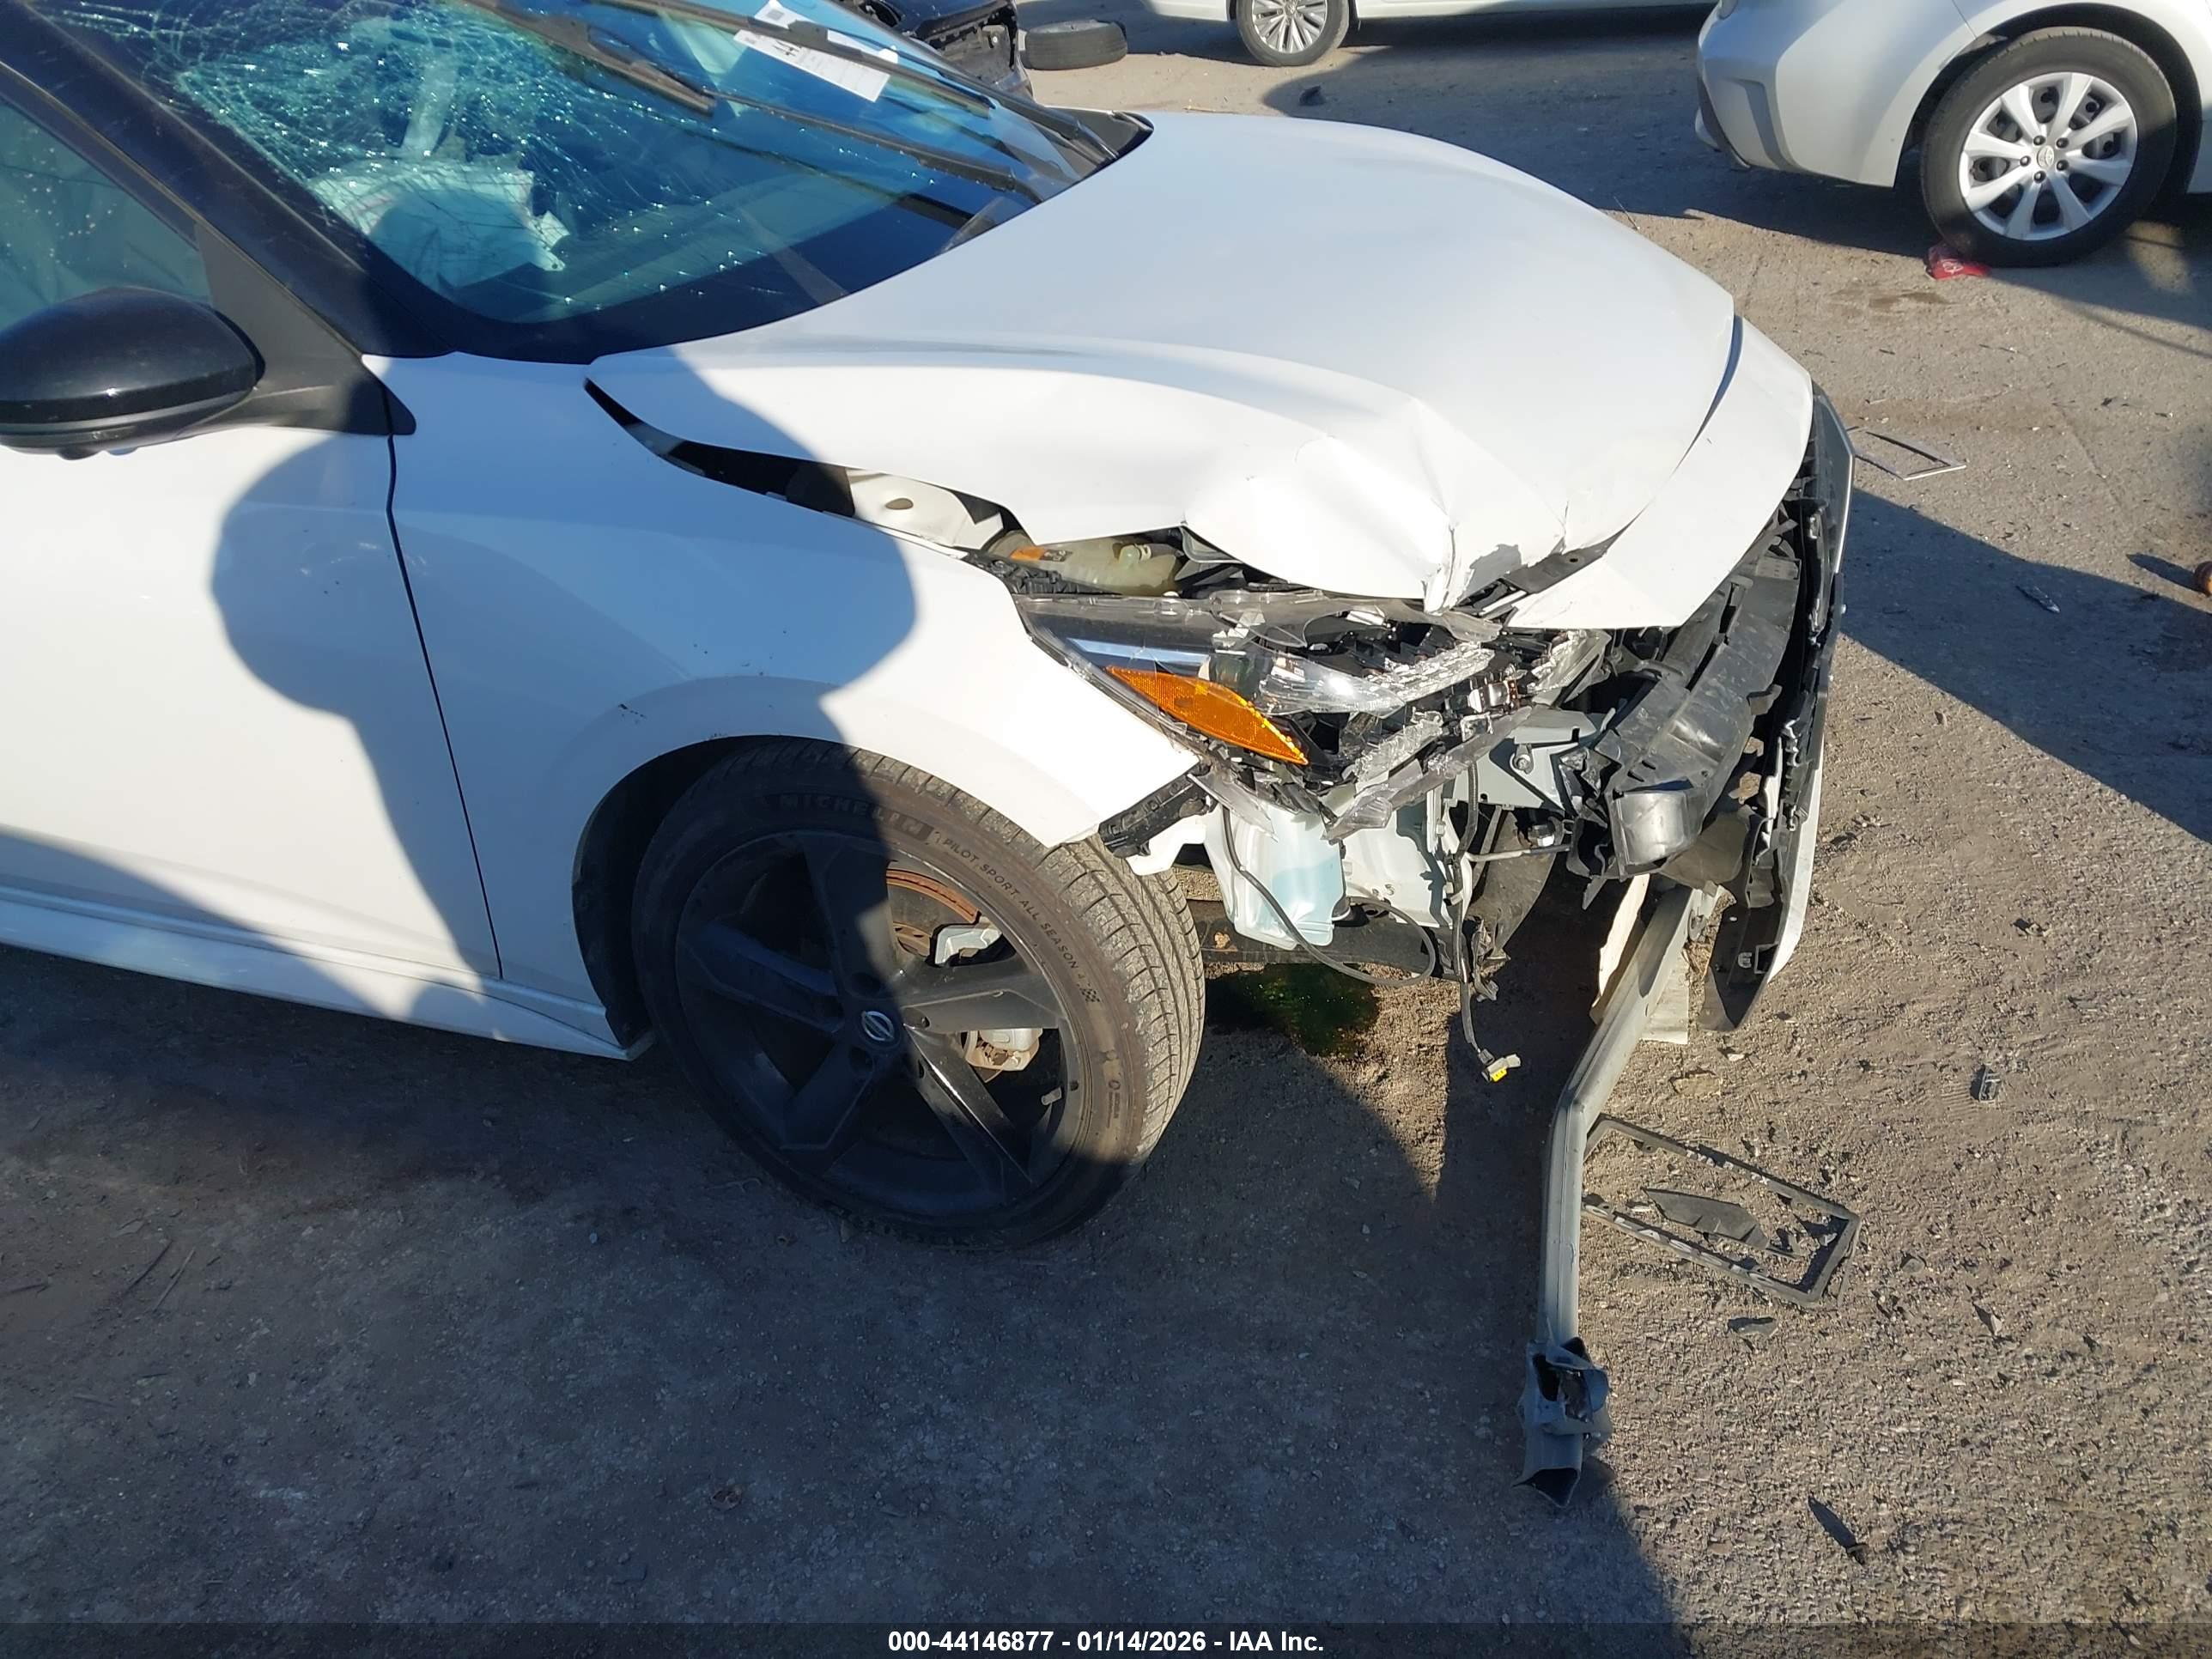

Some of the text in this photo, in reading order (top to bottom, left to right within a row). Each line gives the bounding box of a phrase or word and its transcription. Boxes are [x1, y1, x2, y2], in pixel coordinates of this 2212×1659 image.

[942, 838, 980, 862] PILOT
[979, 864, 1019, 896] SPORT
[1019, 899, 1040, 921] ALL
[1040, 923, 1079, 969] SEASON
